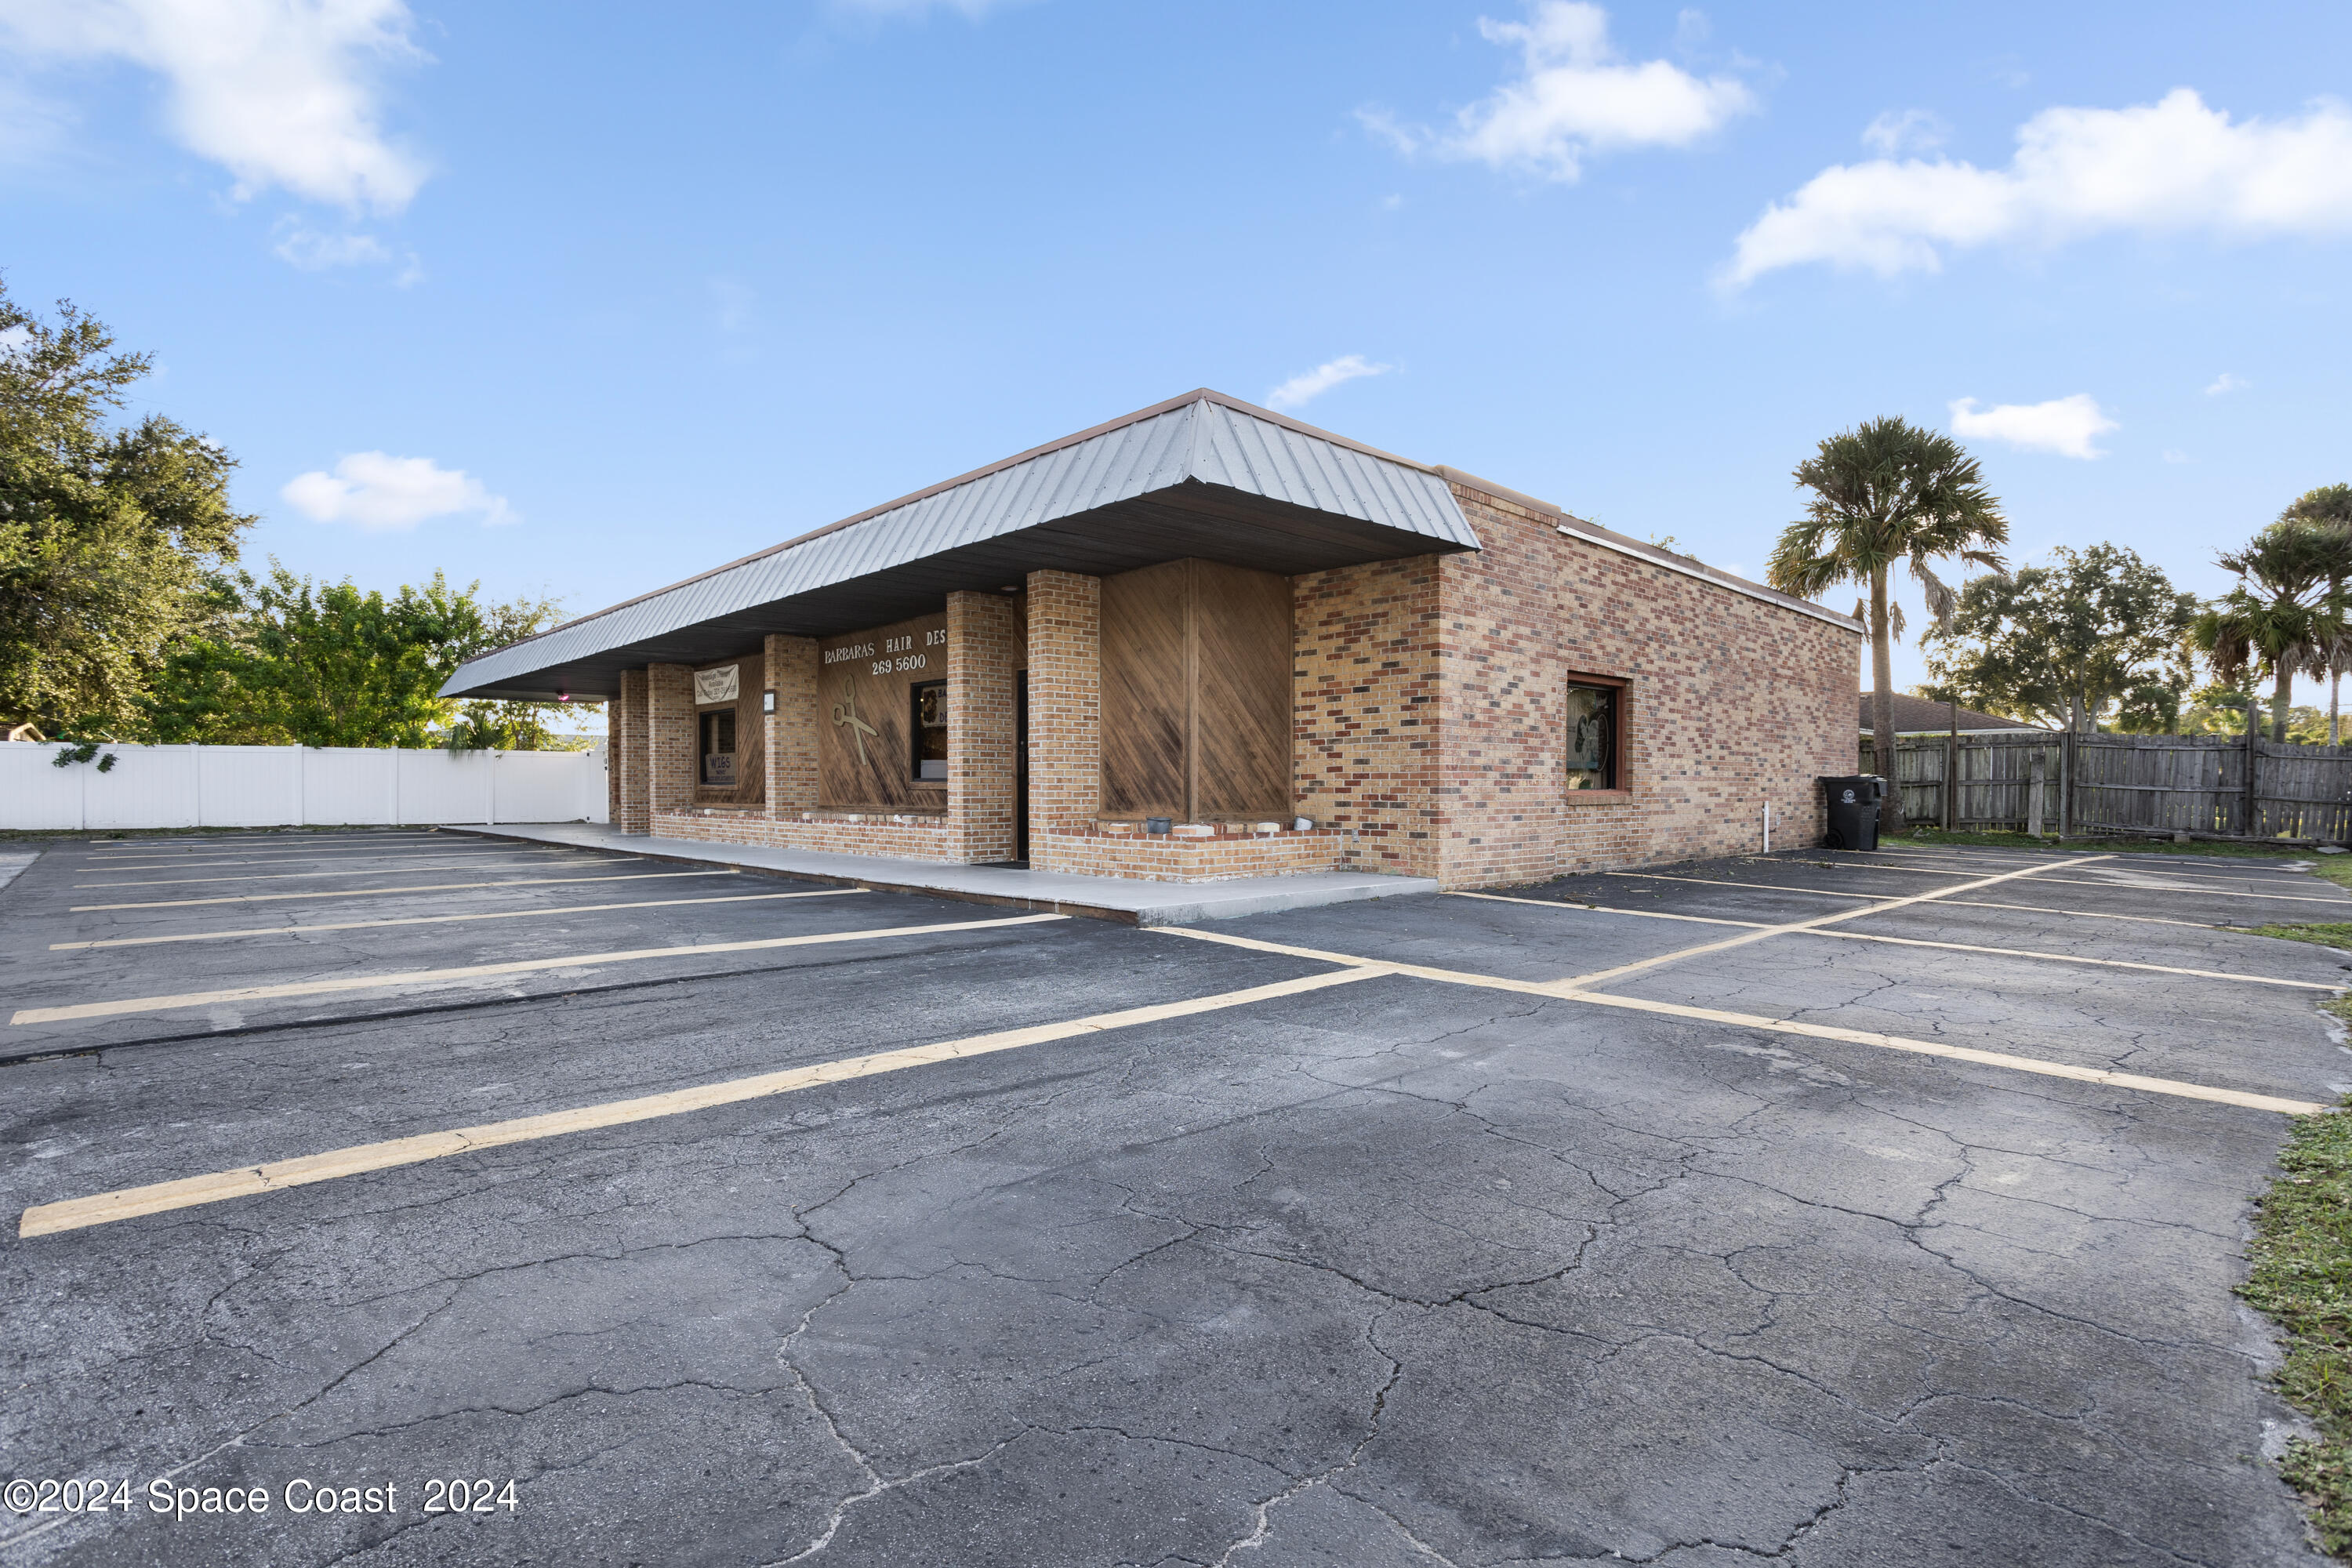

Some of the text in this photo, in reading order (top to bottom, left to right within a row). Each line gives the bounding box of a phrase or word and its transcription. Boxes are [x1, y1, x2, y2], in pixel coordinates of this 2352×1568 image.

[825, 642, 875, 664] BARBARAS
[886, 635, 913, 653] HAIR
[872, 653, 926, 675] 269 5600
[710, 756, 731, 768] WIGS
